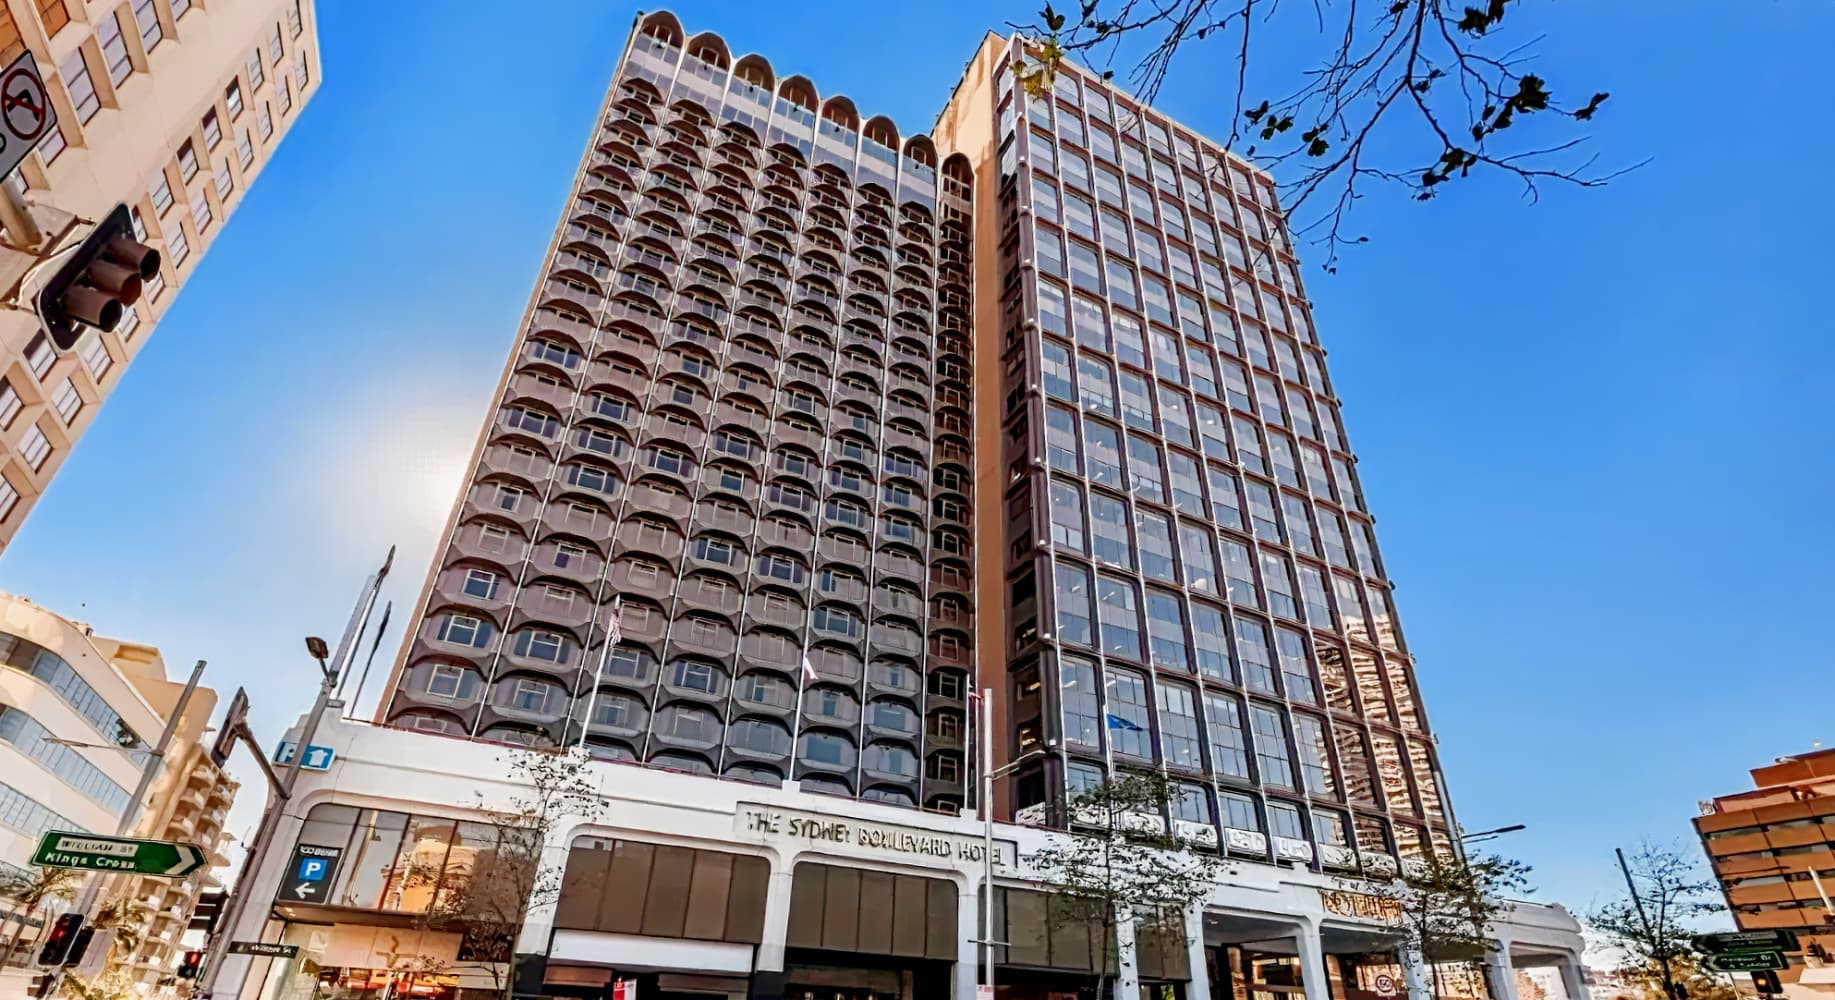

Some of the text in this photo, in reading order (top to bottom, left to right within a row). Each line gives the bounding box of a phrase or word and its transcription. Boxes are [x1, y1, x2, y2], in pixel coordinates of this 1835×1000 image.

[746, 811, 781, 833] THE
[858, 827, 952, 857] BOULEVARD
[44, 852, 136, 869] Kings Cross
[305, 862, 322, 876] P
